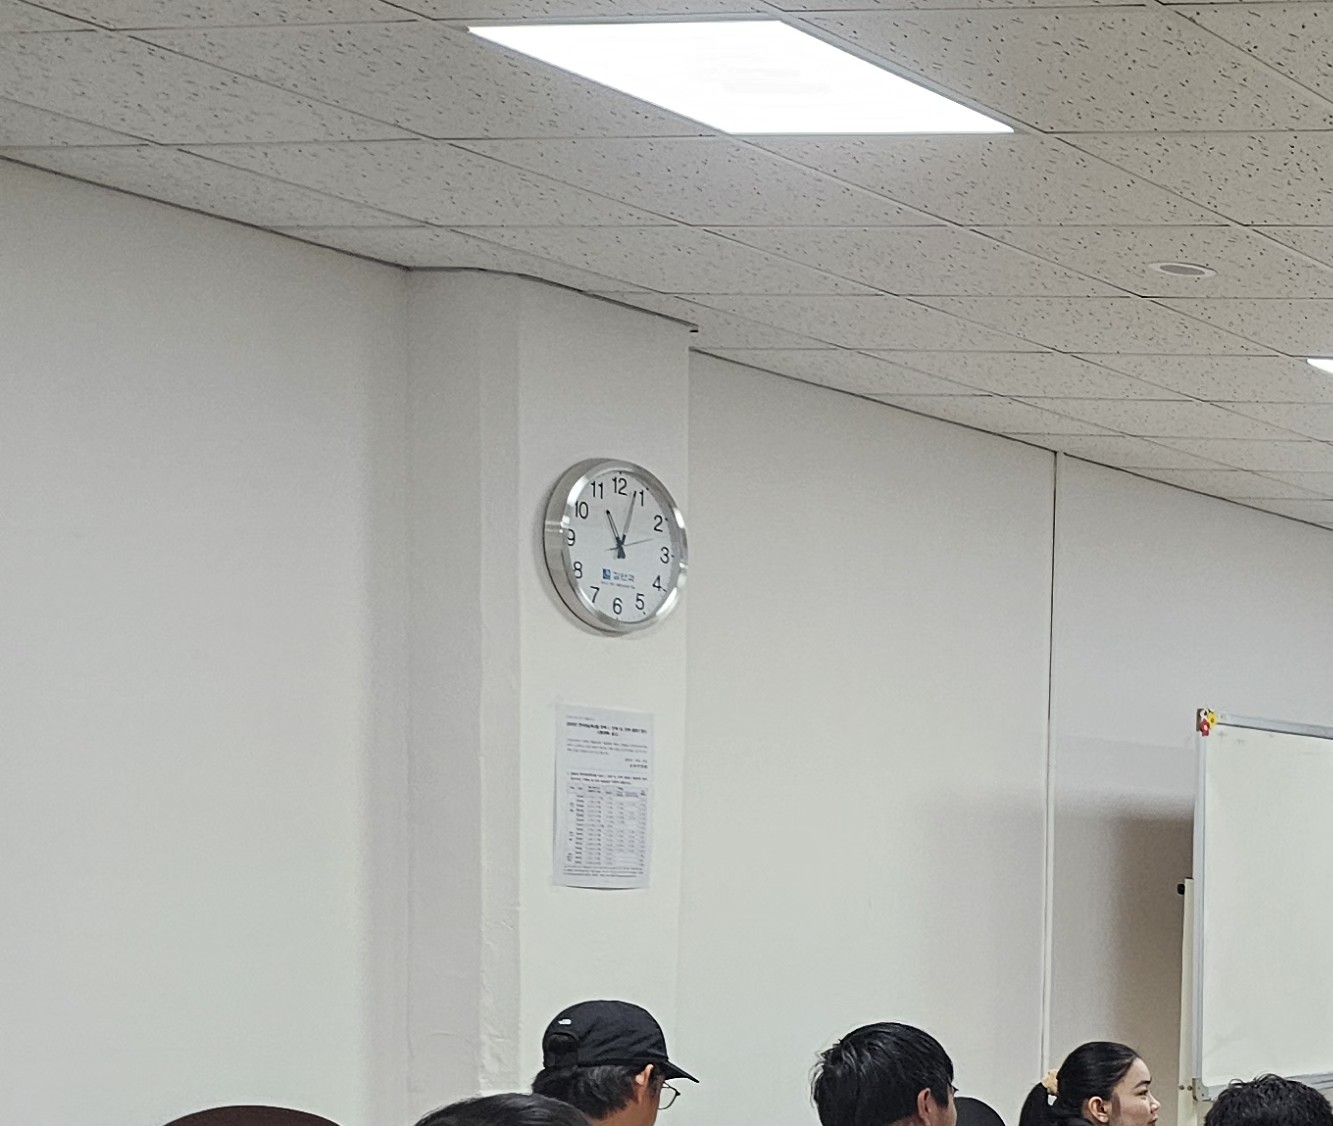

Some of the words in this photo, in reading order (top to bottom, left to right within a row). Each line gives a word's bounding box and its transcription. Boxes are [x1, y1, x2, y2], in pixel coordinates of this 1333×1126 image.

[591, 481, 604, 499] 11
[612, 477, 628, 496] 12
[639, 490, 644, 507] 1
[575, 502, 588, 519] 10
[654, 515, 663, 532] 2
[567, 529, 576, 546] 9
[660, 547, 670, 564] 3
[573, 562, 583, 579] 8
[652, 576, 662, 591] 4
[590, 586, 600, 603] 7
[635, 593, 645, 610] 5
[613, 598, 623, 615] 6
